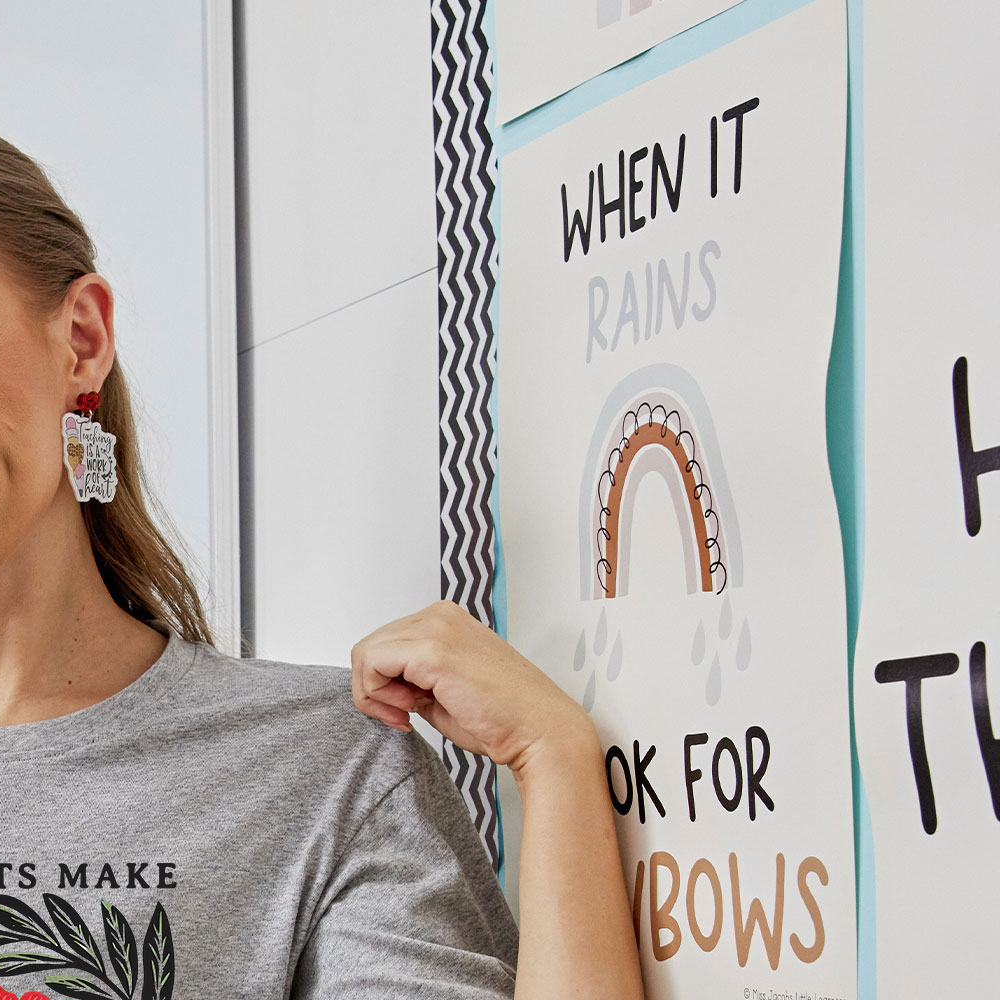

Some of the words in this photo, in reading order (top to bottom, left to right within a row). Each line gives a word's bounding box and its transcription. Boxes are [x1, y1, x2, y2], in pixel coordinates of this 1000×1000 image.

[561, 134, 686, 263] WHEN
[710, 97, 760, 198] IT
[585, 239, 721, 364] RAINS
[76, 419, 113, 454] Teaching
[86, 442, 94, 458] IS
[95, 444, 101, 459] A
[86, 457, 107, 473] WORK
[91, 471, 100, 484] OF
[84, 472, 115, 499] heart
[683, 725, 775, 823] FOR
[57, 862, 178, 890] MAKE
[752, 988, 767, 1000] Miss
